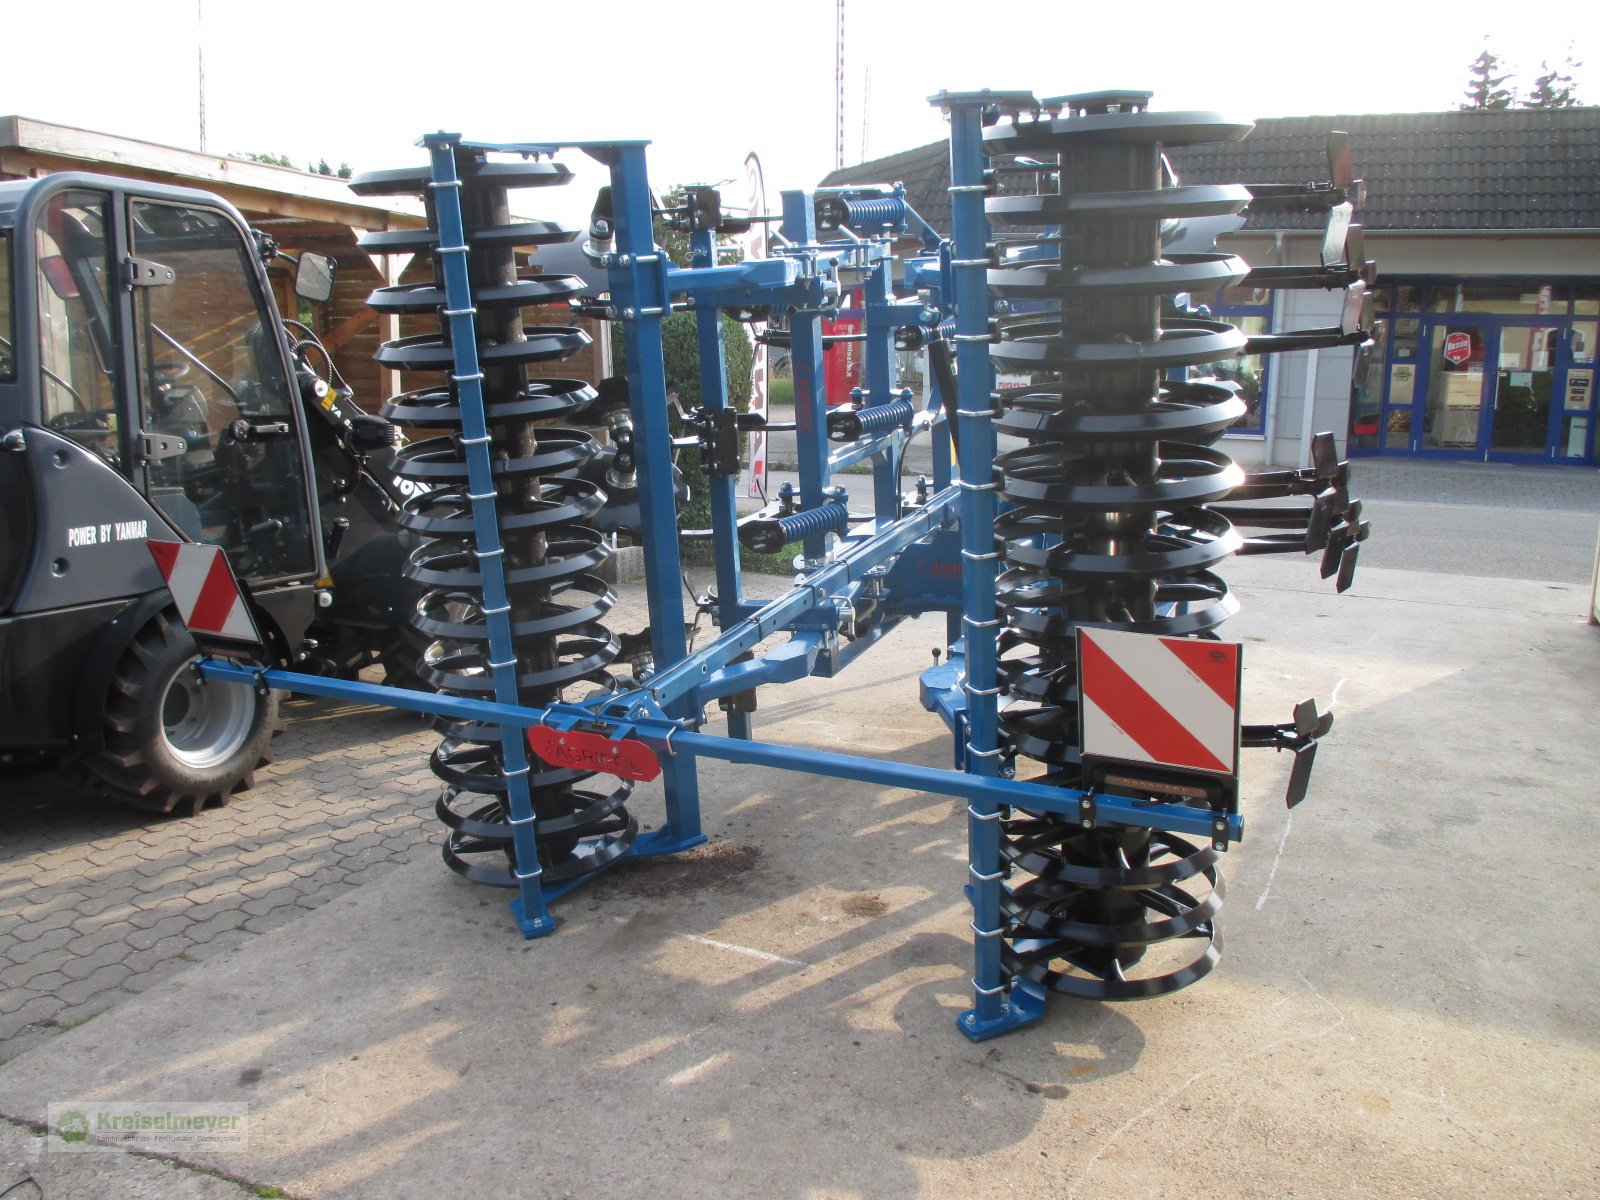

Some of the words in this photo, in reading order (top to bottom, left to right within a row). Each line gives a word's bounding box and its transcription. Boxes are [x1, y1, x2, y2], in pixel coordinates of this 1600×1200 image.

[68, 526, 97, 547] POWER
[100, 524, 112, 543] BY
[115, 520, 147, 540] YANMAR
